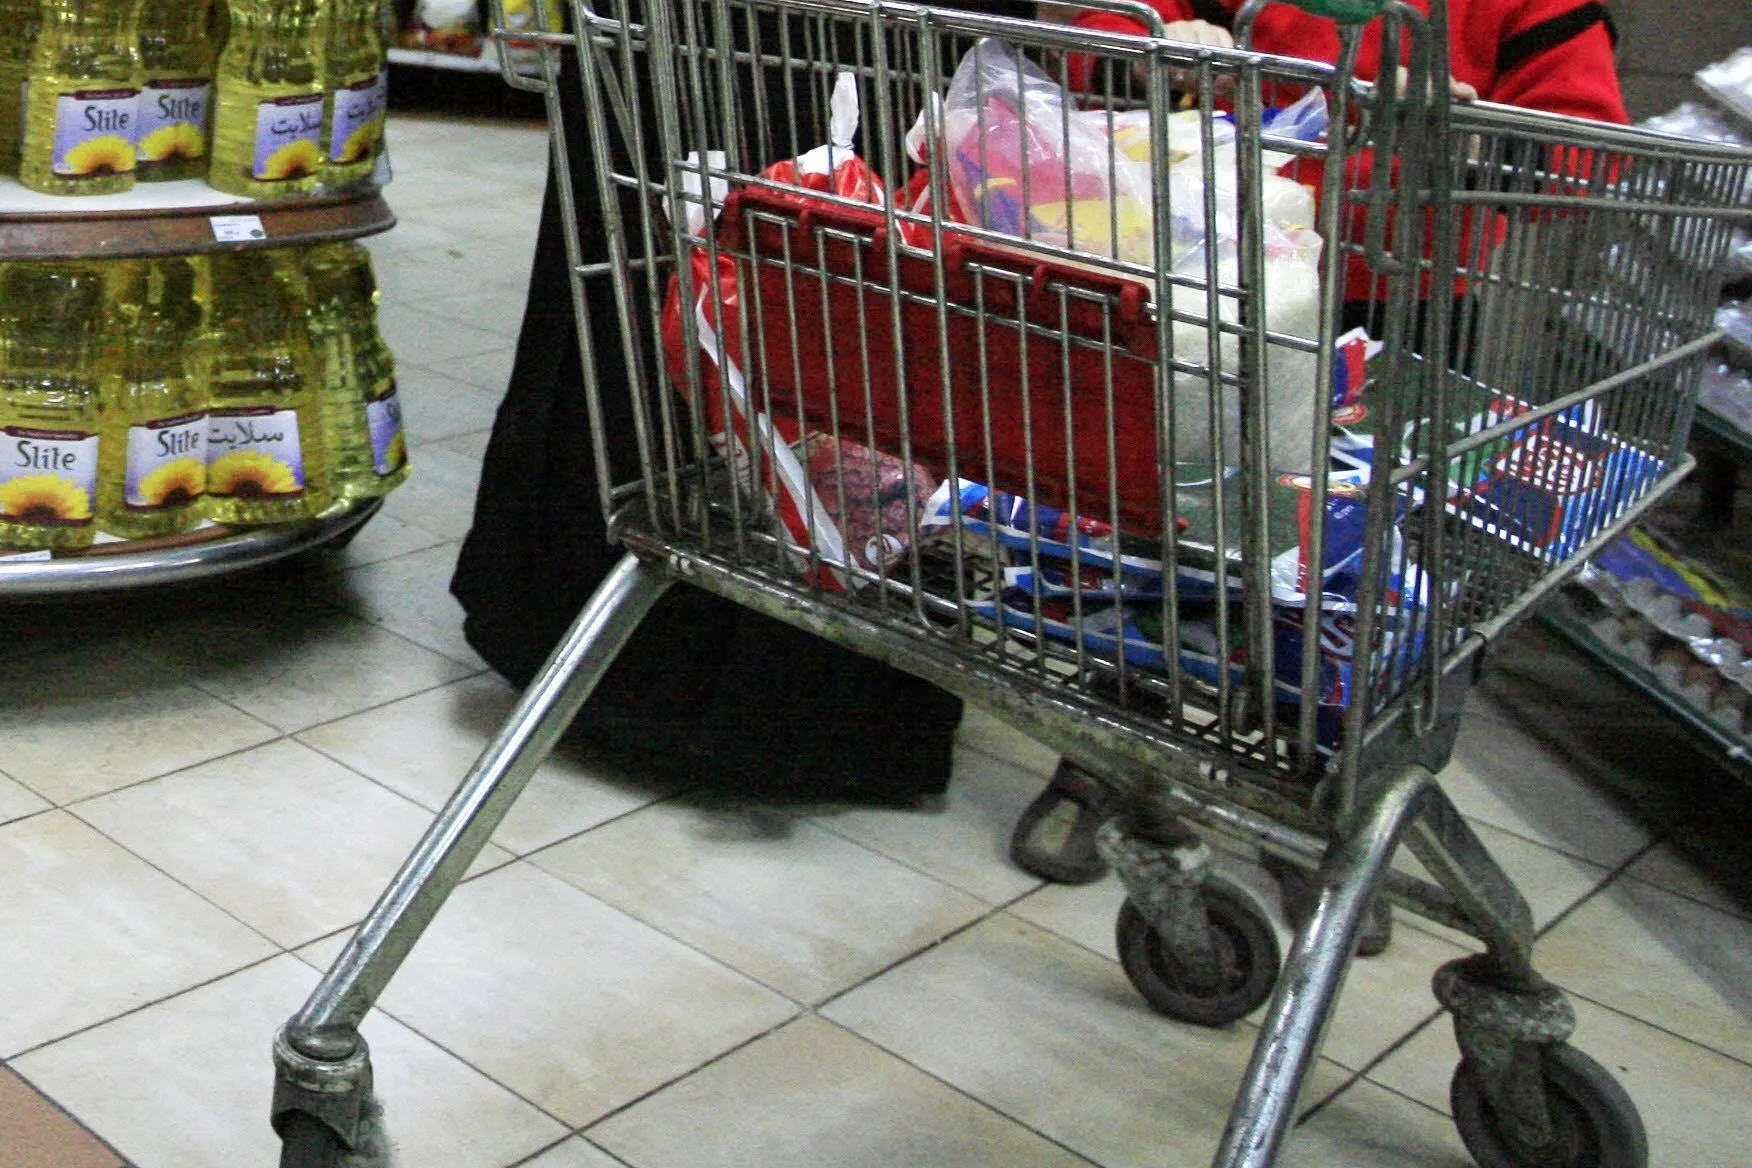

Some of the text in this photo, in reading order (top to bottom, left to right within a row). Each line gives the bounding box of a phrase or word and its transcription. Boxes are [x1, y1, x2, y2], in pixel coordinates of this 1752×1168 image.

[83, 105, 130, 132] Slite
[157, 94, 201, 121] Slite
[157, 429, 200, 457] Slite
[206, 420, 284, 450] سلايت
[16, 440, 76, 471] Slite
